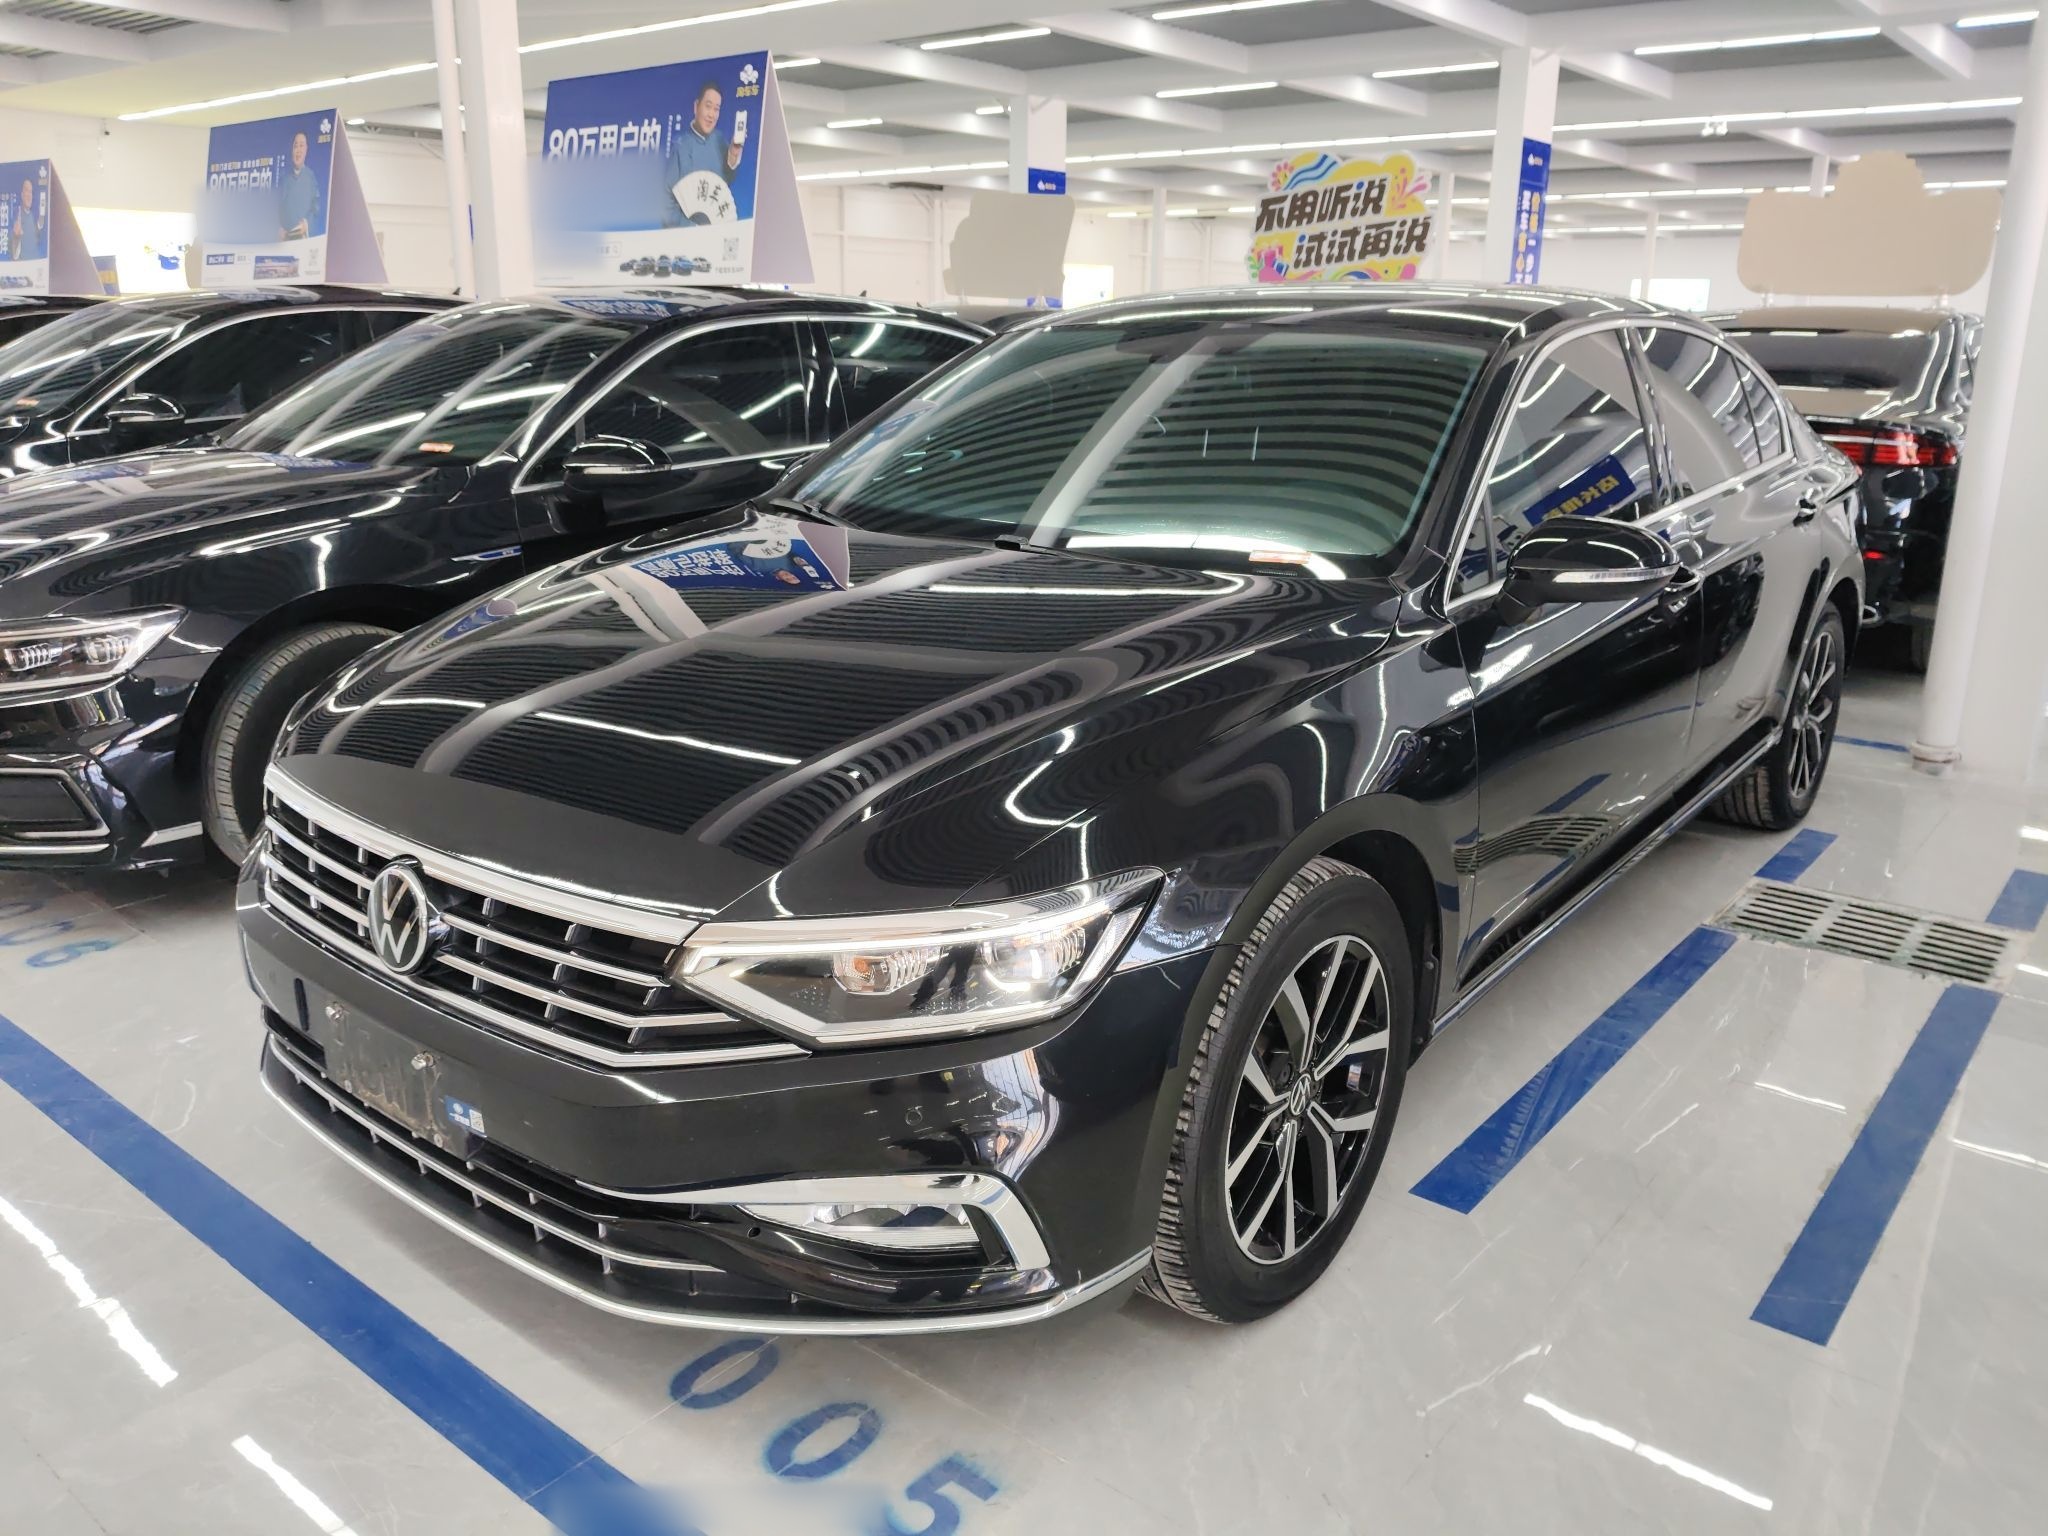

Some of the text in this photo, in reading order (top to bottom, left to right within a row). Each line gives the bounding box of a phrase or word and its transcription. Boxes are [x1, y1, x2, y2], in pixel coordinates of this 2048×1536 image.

[1255, 178, 1388, 232] 不用听说
[1293, 216, 1432, 270] 试试再说
[669, 1338, 1000, 1536] 005
